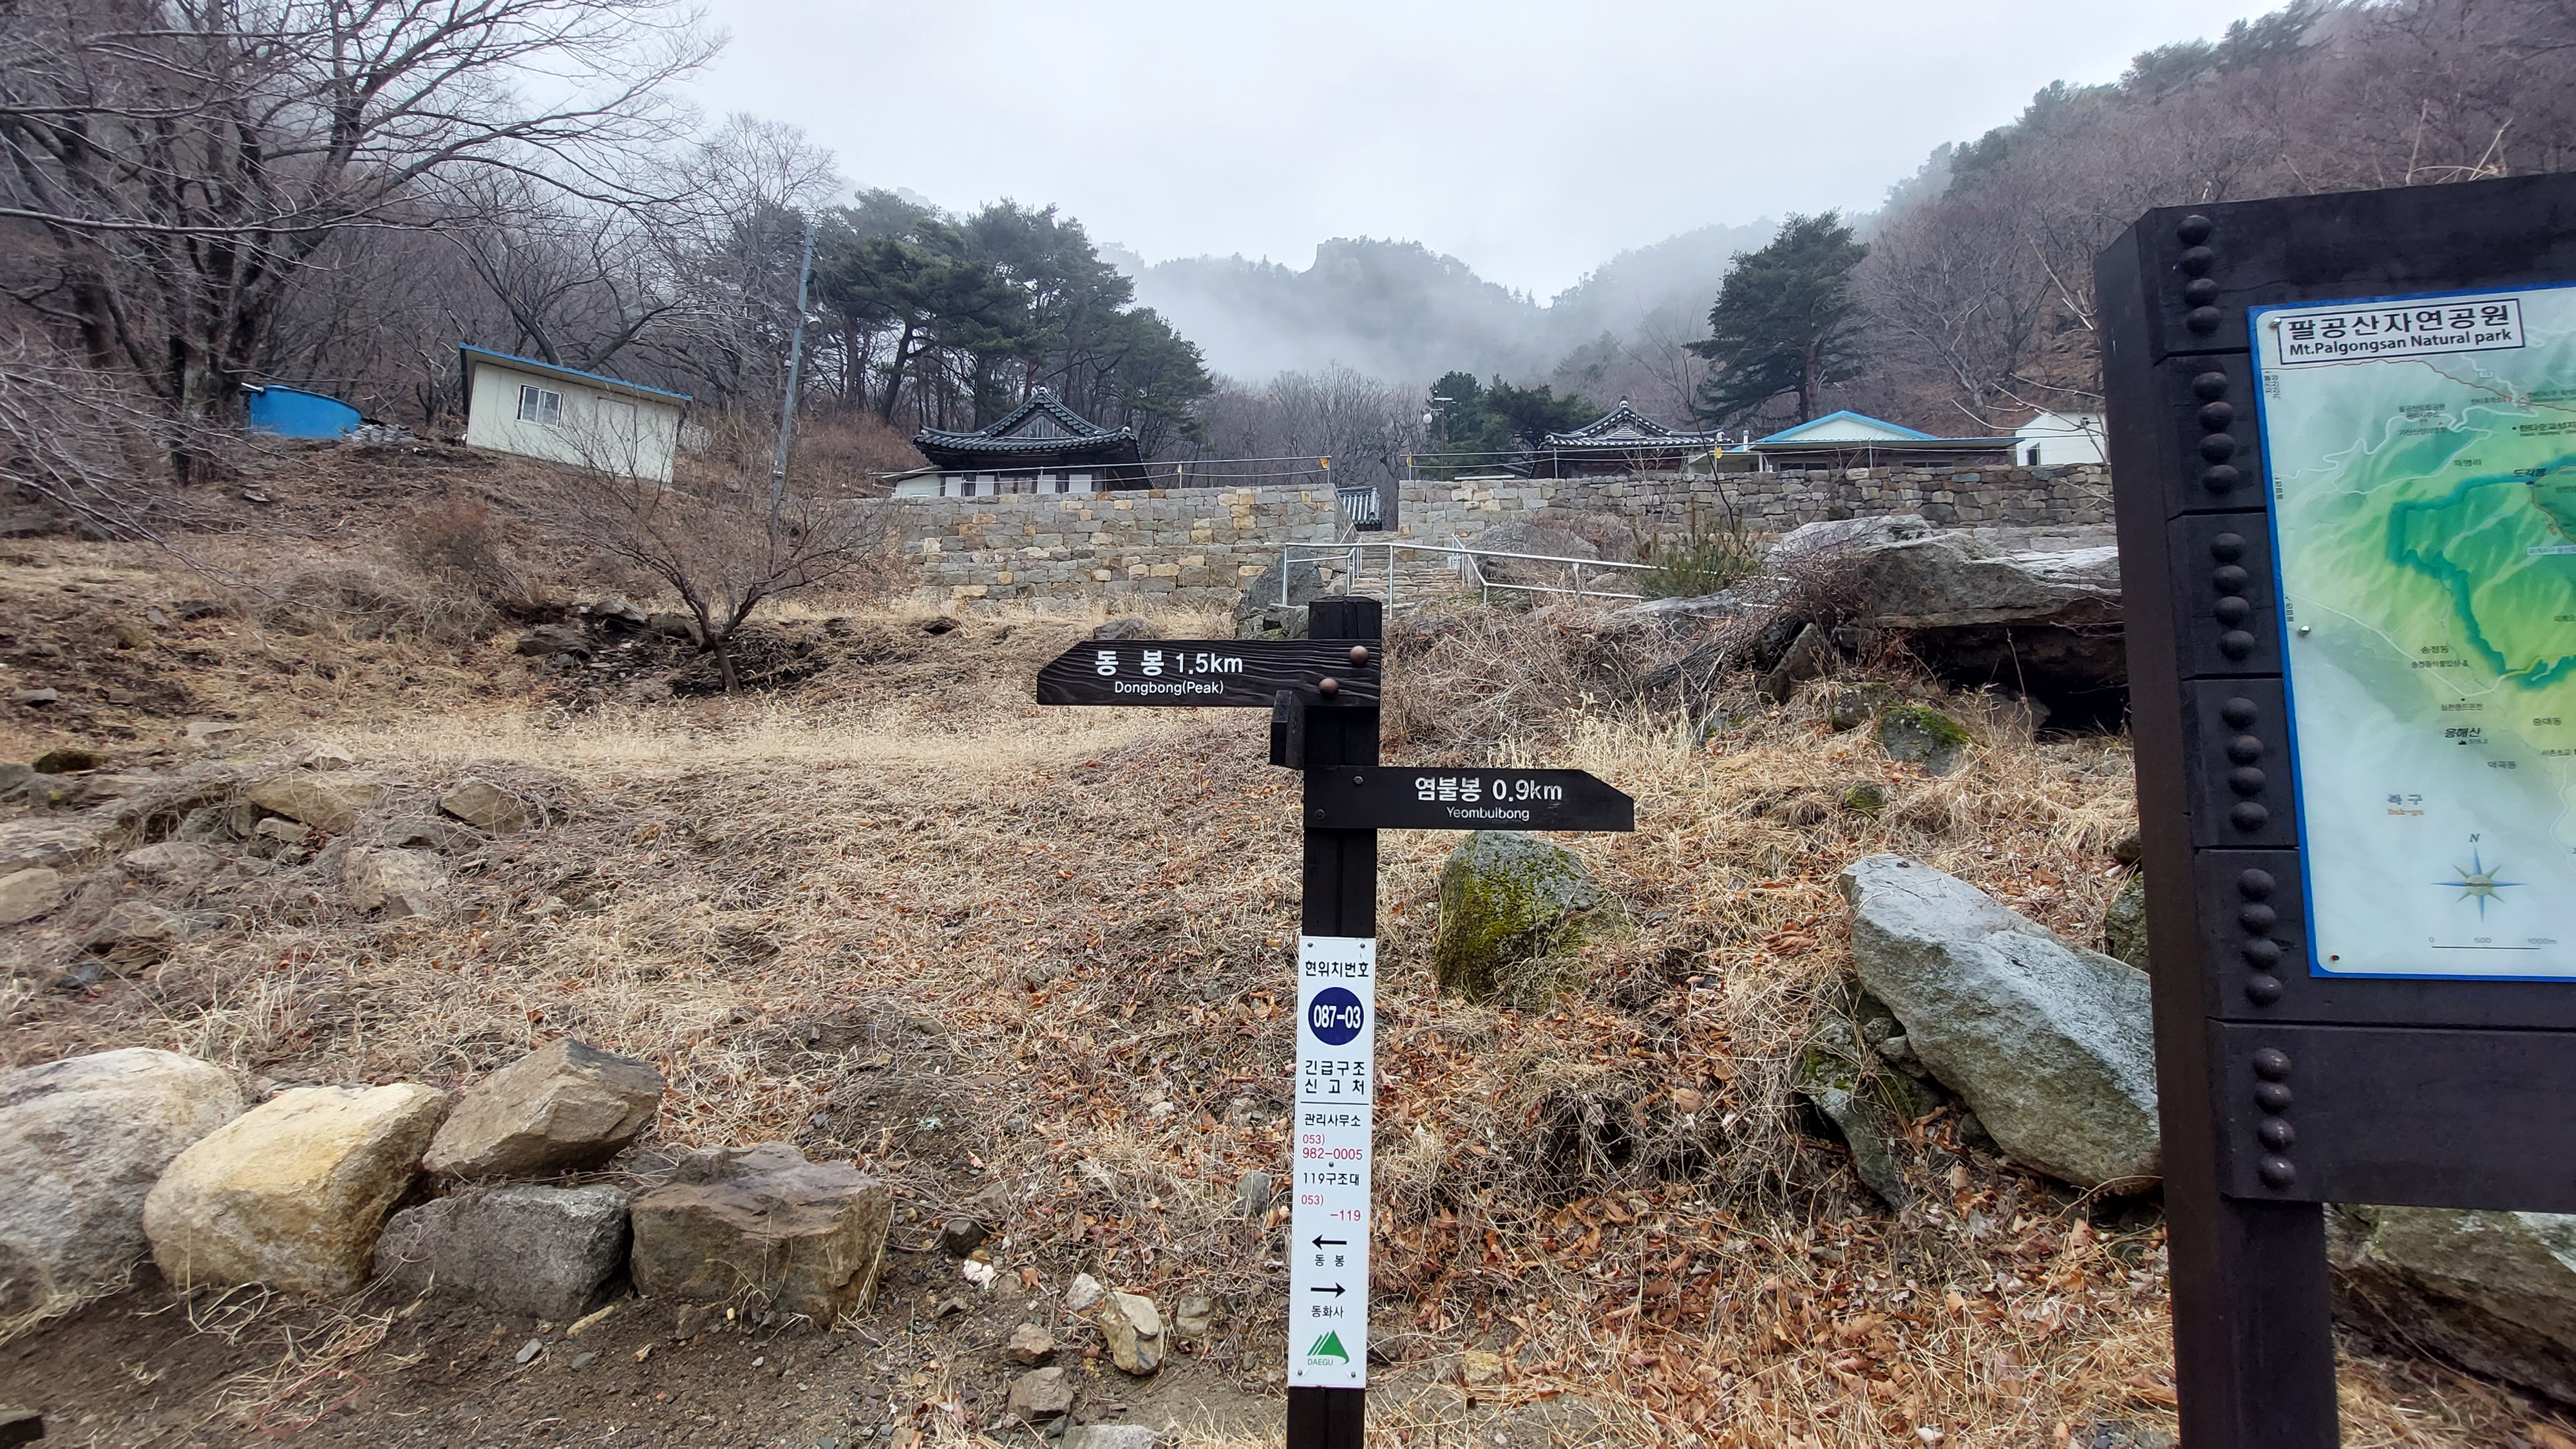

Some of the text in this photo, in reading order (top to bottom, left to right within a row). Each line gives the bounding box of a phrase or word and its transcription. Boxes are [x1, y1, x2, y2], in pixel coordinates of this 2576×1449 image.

[2288, 304, 2510, 340] 팔공산자연공원
[2289, 328, 2512, 356] Mt.Palgongsan Natural park
[1176, 652, 1243, 675] 1.5km
[1114, 680, 1224, 696] Dongbong(Peak)
[1415, 777, 1562, 802] 염불봉 0.9km
[1446, 806, 1530, 821] Yeombulbong
[2470, 834, 2480, 842] N
[1305, 961, 1369, 978] 현위치번호
[1313, 1005, 1361, 1028] 087-03
[1305, 1061, 1365, 1076] 긴급구조
[1304, 1113, 1361, 1127] 관리사무소
[1302, 1134, 1325, 1146] 053)
[1302, 1148, 1363, 1160] 982-0005
[1303, 1173, 1359, 1186] 119구조대
[1301, 1195, 1324, 1206] 053)
[1330, 1209, 1361, 1221] -119
[1311, 1305, 1344, 1318] 동화사
